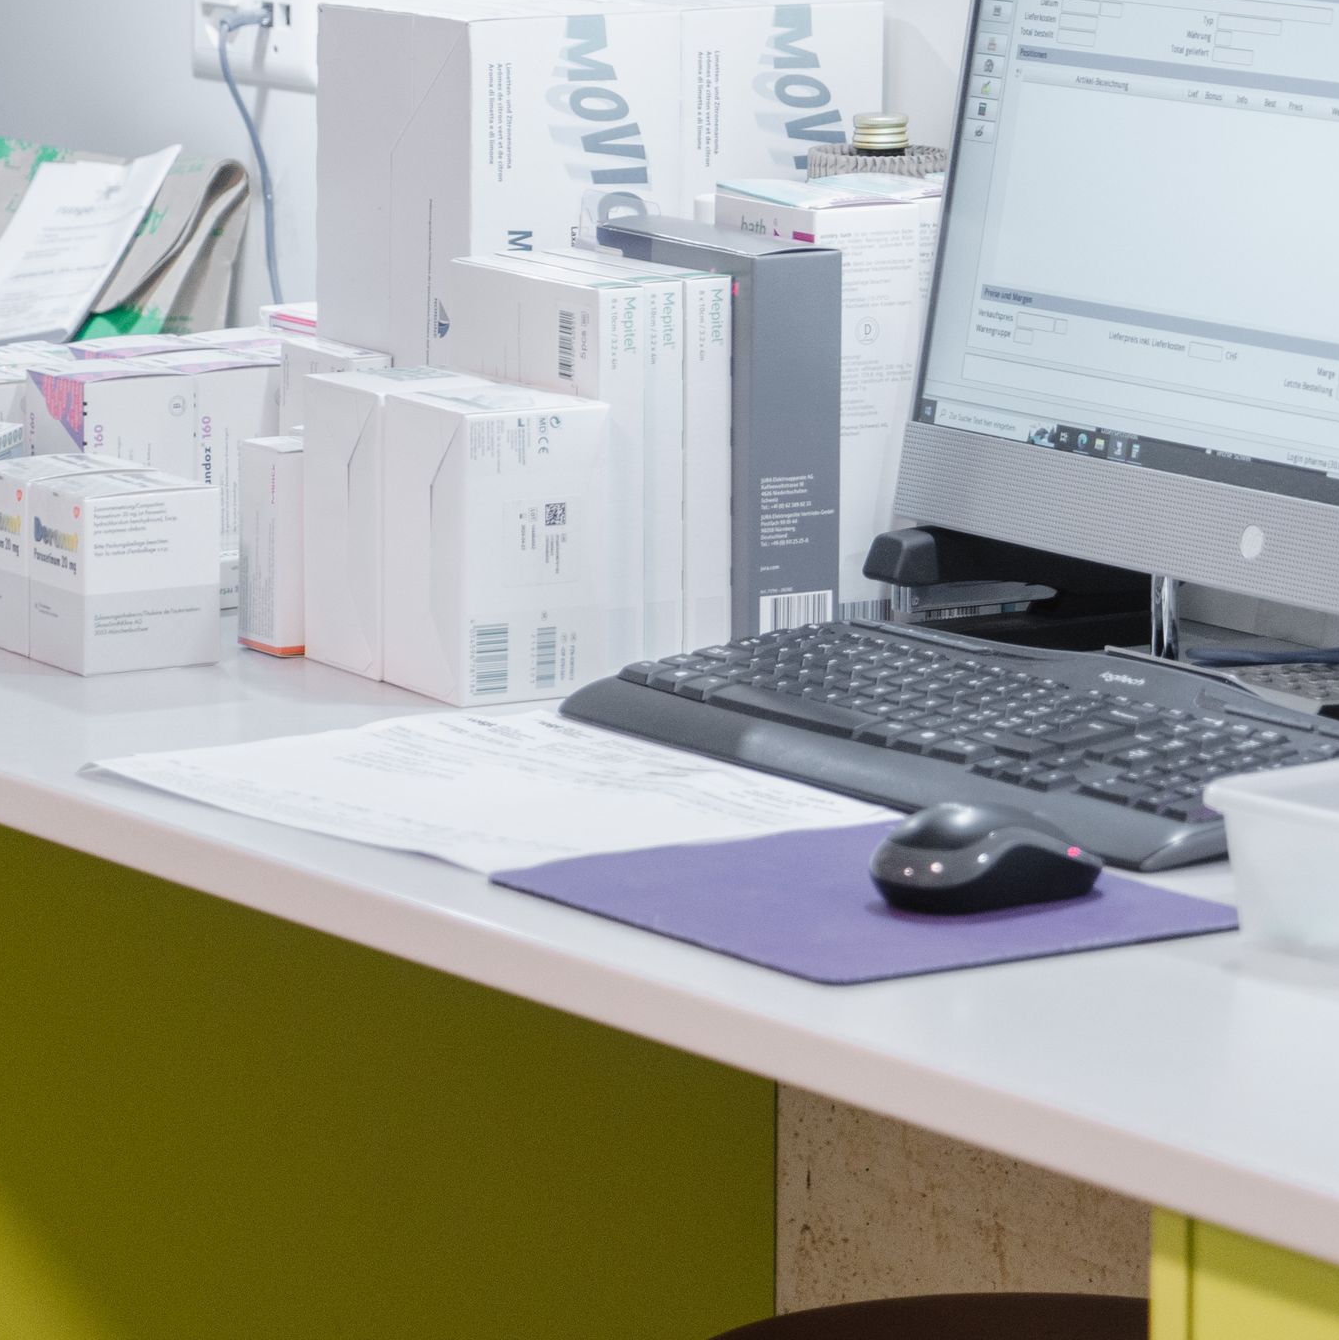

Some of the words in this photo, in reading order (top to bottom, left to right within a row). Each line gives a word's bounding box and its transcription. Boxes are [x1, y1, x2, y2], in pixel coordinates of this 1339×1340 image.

[774, 3, 847, 170] MOV
[624, 296, 637, 353] Mepitel
[663, 292, 676, 348] Mepitel
[711, 288, 724, 343] Mepitel
[94, 424, 104, 448] 160
[201, 415, 212, 440] 160
